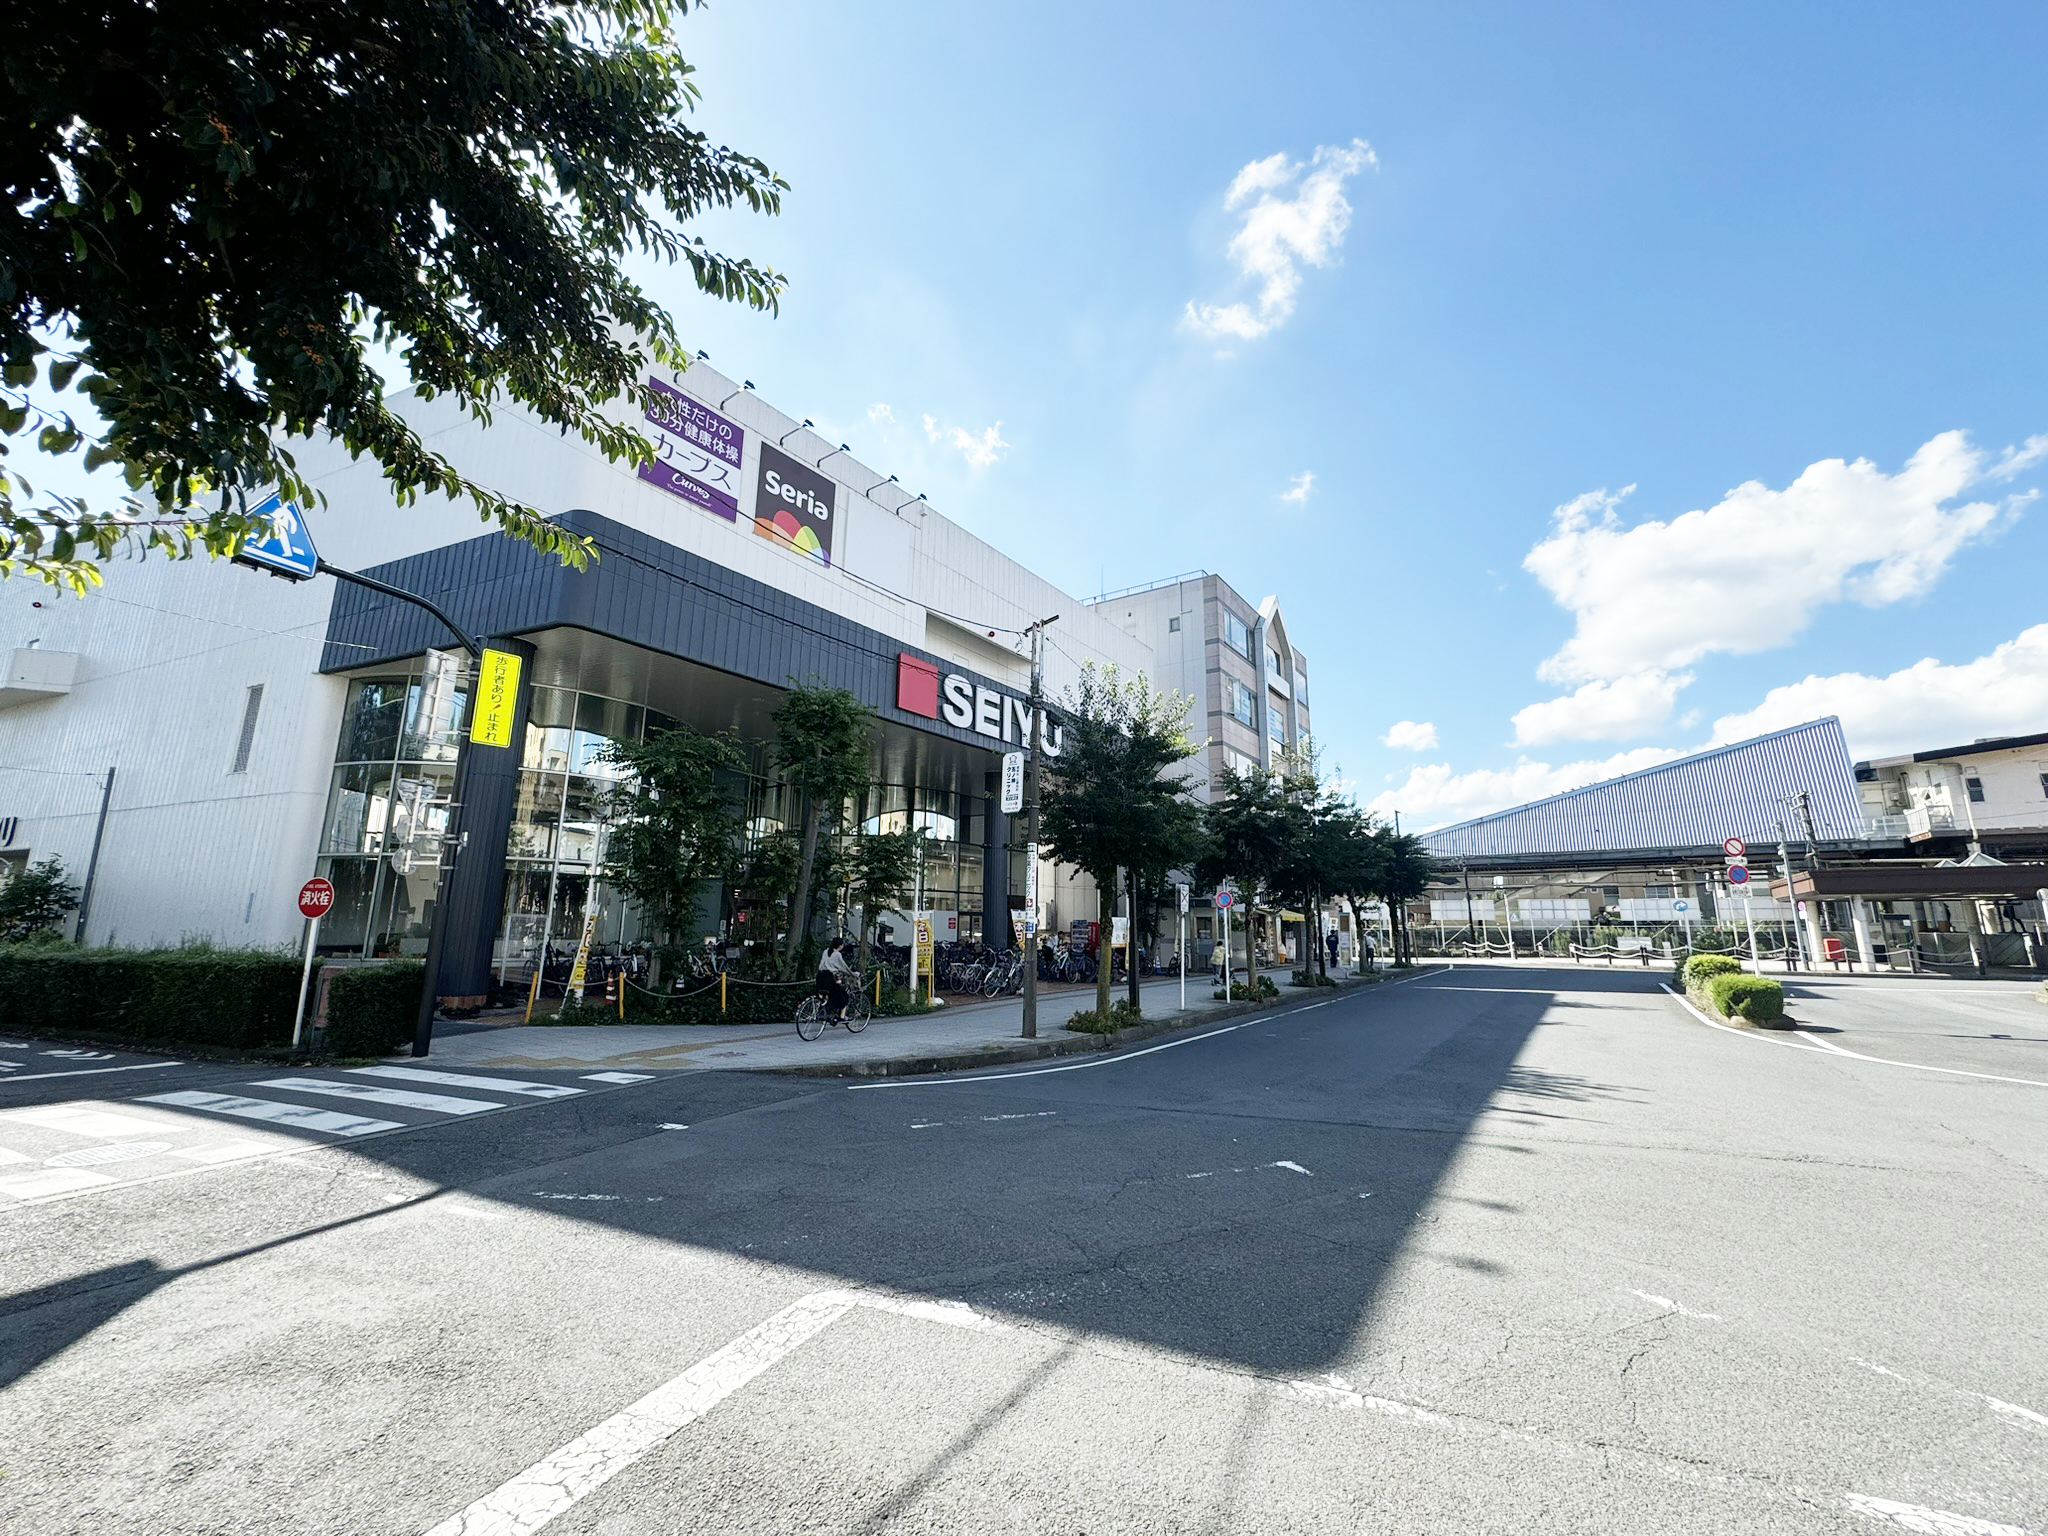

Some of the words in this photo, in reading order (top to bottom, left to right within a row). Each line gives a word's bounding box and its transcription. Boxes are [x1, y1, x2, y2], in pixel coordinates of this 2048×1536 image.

[653, 433, 732, 490] カーブス
[672, 472, 711, 499] Curves
[765, 470, 829, 521] Seria
[942, 673, 1063, 757] SEIYU
[300, 890, 331, 906] 消火栓
